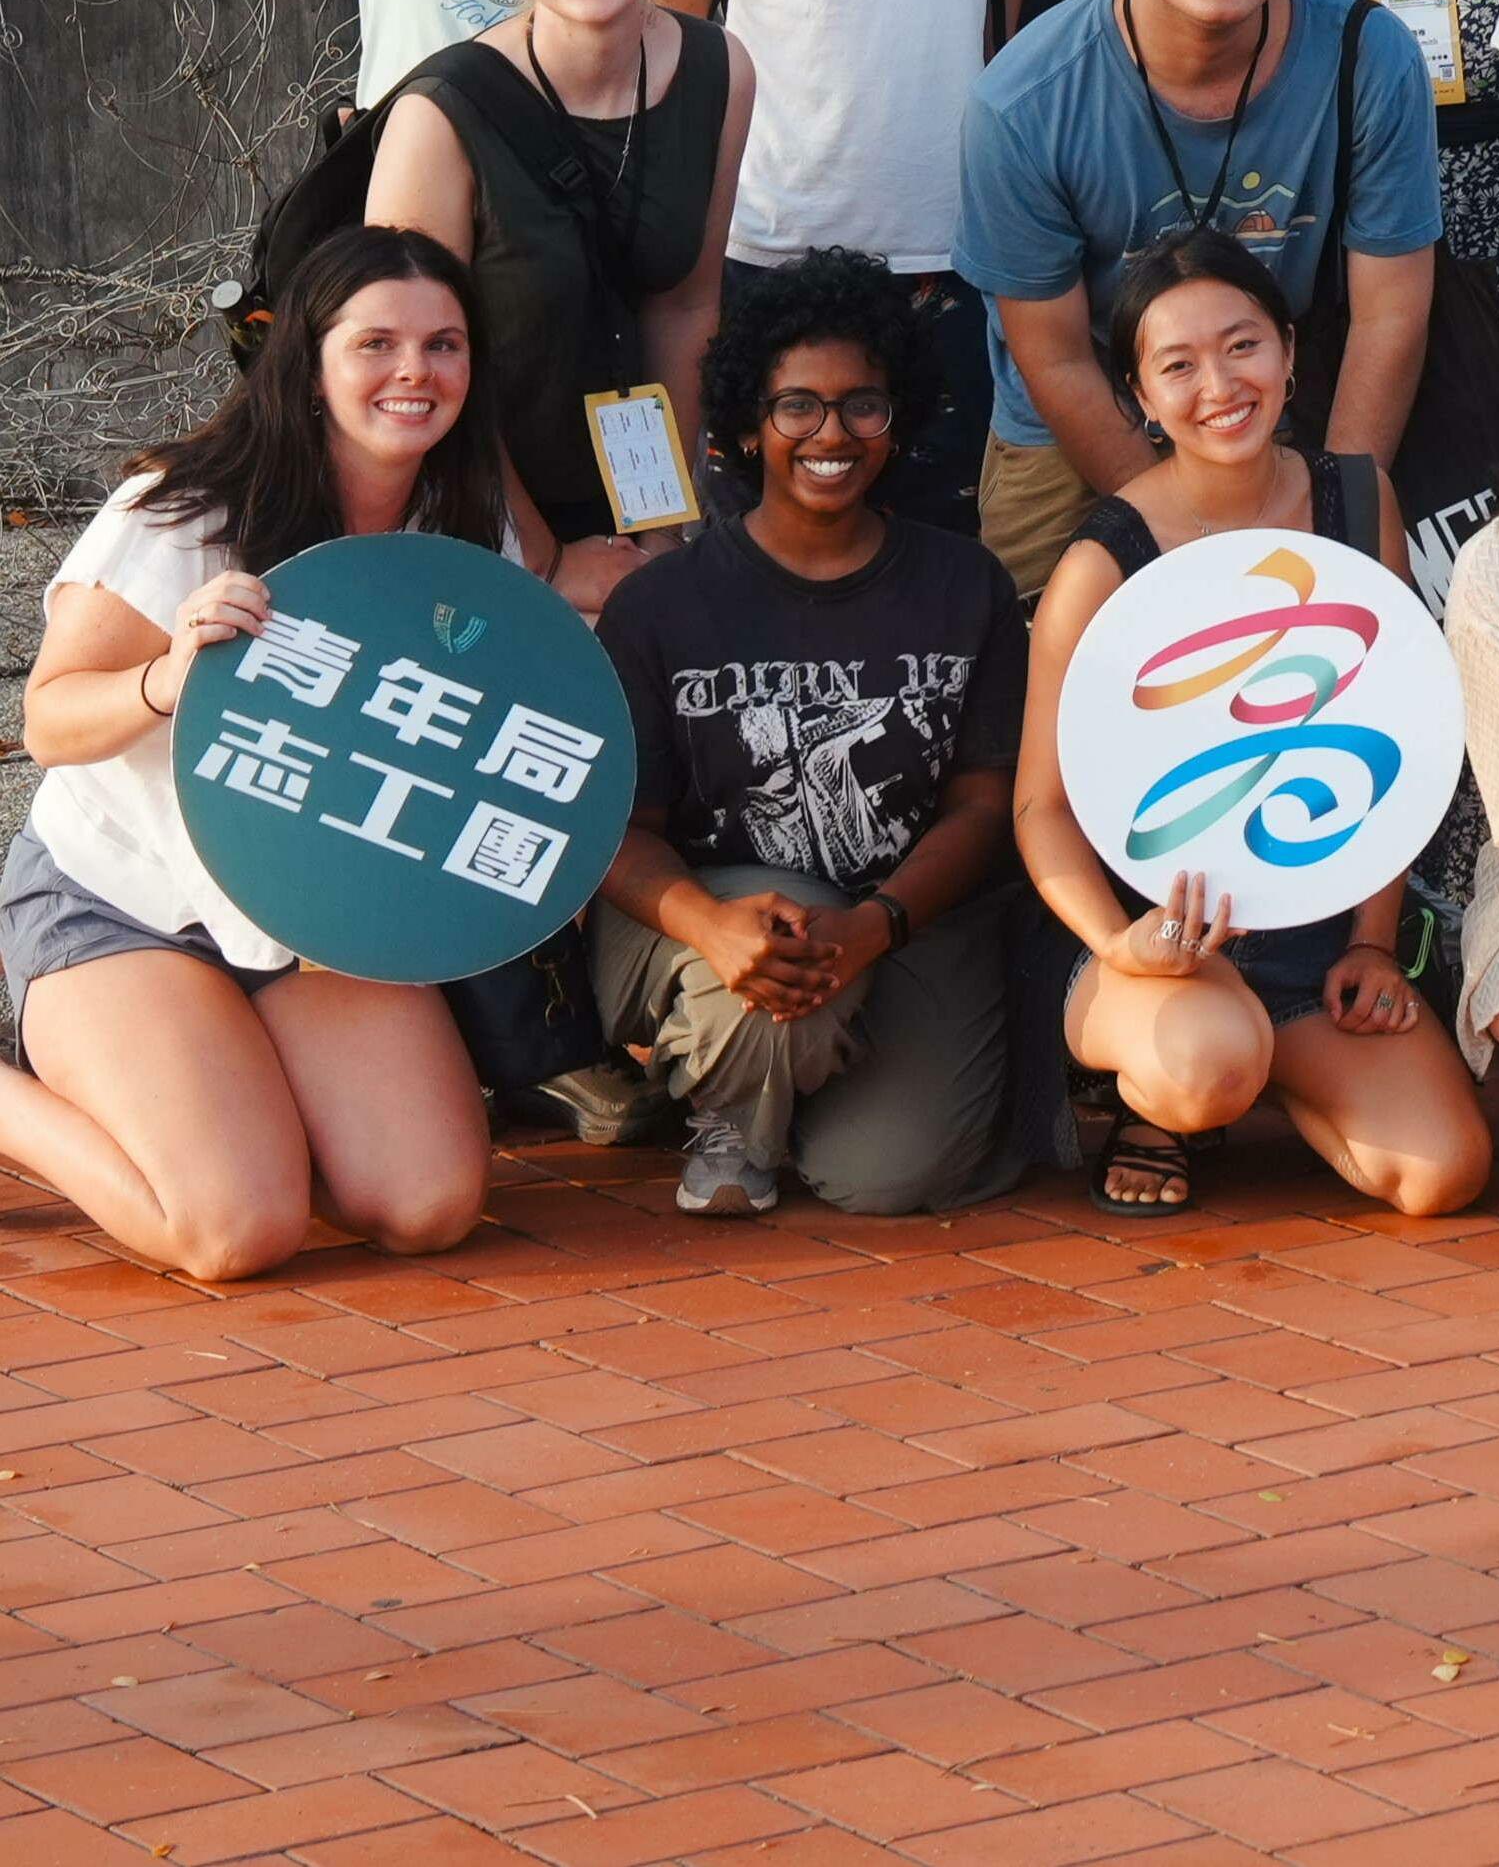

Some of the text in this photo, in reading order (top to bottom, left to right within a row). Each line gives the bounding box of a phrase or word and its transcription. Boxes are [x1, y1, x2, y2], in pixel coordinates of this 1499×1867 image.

[234, 610, 606, 804] 青年局
[671, 659, 866, 718] TURN
[192, 709, 571, 906] 志工團
